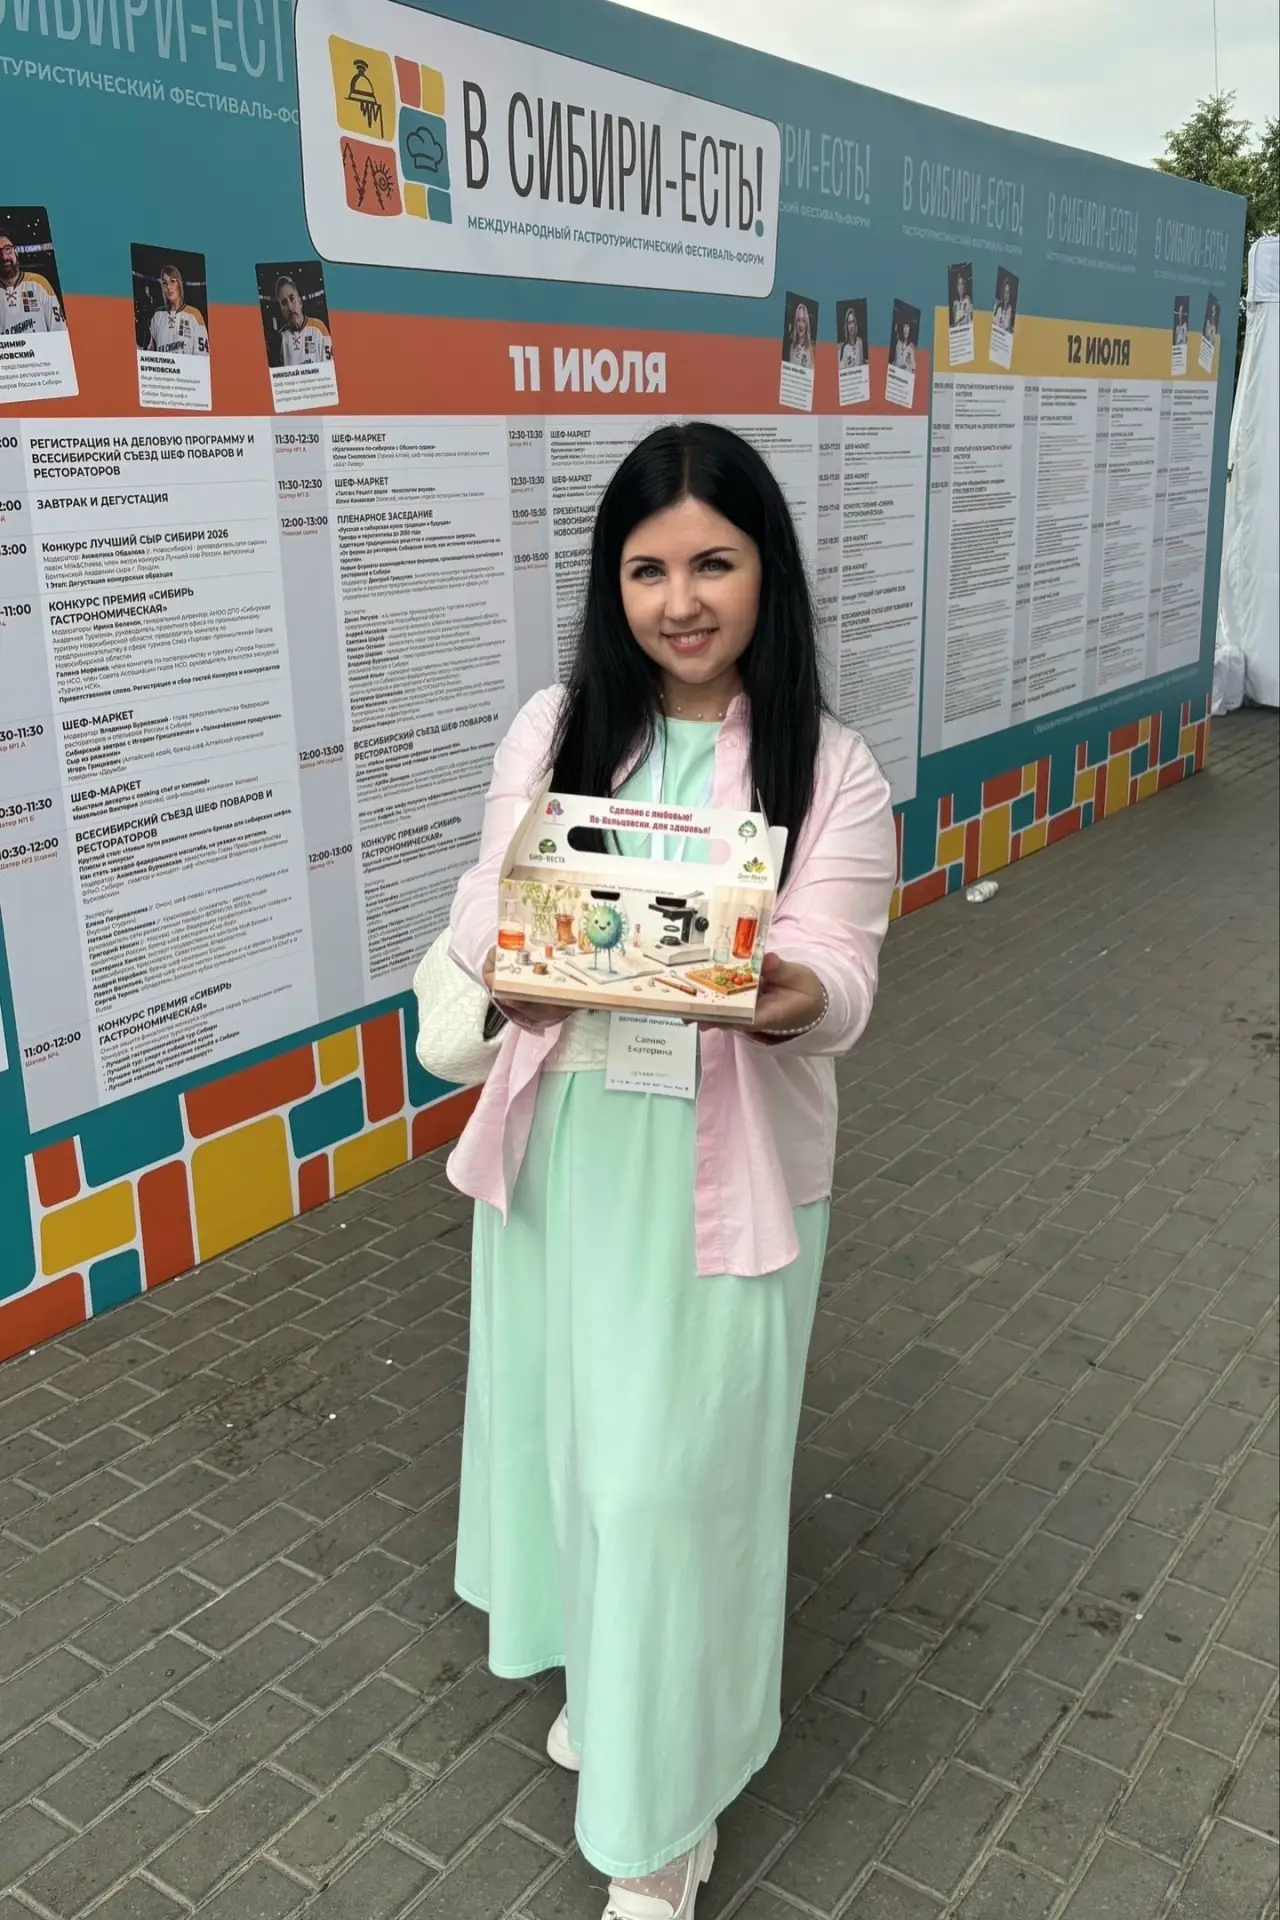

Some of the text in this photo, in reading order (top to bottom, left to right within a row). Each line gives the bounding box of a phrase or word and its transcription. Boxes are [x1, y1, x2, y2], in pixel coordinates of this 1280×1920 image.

[463, 80, 765, 238] В СИБИРИ-ЕСТЬ!
[780, 122, 871, 206] РИ-ЕСТЬ!
[902, 155, 1025, 236] В СИБИРИ-ЕСТЬ!
[1047, 191, 1056, 239] В
[467, 215, 764, 266] МЕЖДУНАРОДНЫЙ ГАСТРОТУРИСТИЧЕСКИЙ ФЕСТИВАЛЬ-ФОРУМ
[1068, 335, 1131, 366] 12 ИЮЛЯ
[140, 356, 175, 364] АНЖЕЛИКА
[140, 365, 181, 374] БУРКОВСКАЯ
[272, 369, 300, 379] НИКОЛАЙ
[509, 345, 666, 394] 11 ИЮЛЯ
[30, 434, 254, 449] РЕГИСТРАЦИЯ НА ДЕЛОВУЮ ПРОГРАММУ И
[275, 434, 320, 444] 11:30-12:30
[332, 433, 386, 443] ШЕФ-МАРКЕТ
[508, 430, 543, 440] 12:30-13:30
[550, 430, 591, 439] ШЕФ-МАРКЕТ
[32, 448, 244, 464] ВСЕСИБИРСКИЙ СЪЕЗД ШЕФ ПОВАРОВ И
[33, 466, 120, 478] РЕСТОРАТОРОВ
[552, 475, 592, 484] ШЕФ-МАРКЕТ
[278, 479, 322, 490] 11:30-12:30
[335, 477, 388, 487] ШЕФ-МАРКЕТ
[510, 476, 545, 486] 12:30-13:30
[37, 493, 168, 510] ЗАВТРАК И ДЕГУСТАЦИЯ
[553, 505, 595, 515] ПРЕЗЕНТАЦИЯ
[281, 516, 328, 527] 12:00-13:00
[337, 510, 433, 524] ПЛЕНАРНОЕ ЗАСЕДАНИЕ
[512, 508, 546, 518] 13:00-15:30
[42, 529, 229, 553] Конкурс ЛУЧШИЙ СЫР СИБИРИ 2026
[81, 551, 114, 559] Анжелика
[514, 552, 549, 563] 13:00-15:00
[50, 581, 67, 589] Этап:
[68, 578, 105, 588] Дегустация
[107, 575, 144, 584] конкурсных
[145, 571, 173, 580] образцов
[49, 588, 194, 612] КОНКУРС ПРЕМИЯ «СИБИРЬ
[50, 604, 168, 626] ГАСТРОНОМИЧЕСКАЯ»
[56, 670, 80, 678] Галина
[59, 689, 111, 703] Приветственное
[113, 687, 132, 695] слово.
[133, 679, 172, 692] Регистрация
[177, 677, 191, 685] сбор
[62, 710, 134, 731] ШЕФ-МАРКЕТ
[100, 724, 132, 734] Владимир
[133, 717, 168, 729] Бурковский
[353, 713, 499, 750] ВСЕСИБИРСКИЙ СЪЕЗД ШЕФ ПОВАРОВ И
[299, 743, 344, 762] 12:00-13:00
[354, 741, 414, 762] РЕСТОРАТОРОВ
[71, 780, 141, 803] ШЕФ-МАРКЕТ
[104, 796, 130, 806] десерты
[136, 788, 160, 798] cooking
[160, 785, 173, 793] chef
[75, 789, 273, 842] ВСЕСИБИРСКИЙ СЪЕЗД ШЕФ ПОВАРОВ И
[609, 806, 643, 816] Сделано
[652, 811, 693, 821] любовью!
[361, 815, 462, 850] КОНКУРС ПРЕМИЯ «СИБИРЬ
[652, 822, 668, 830] для
[76, 829, 158, 855] РЕСТОРАТОРОВ
[361, 832, 443, 860] ГАСТРОНОМИЧЕСКАЯ»
[308, 843, 353, 864] 12:00-13:00
[98, 982, 232, 1033] КОНКУРС ПРЕМИЯ «СИБИРЬ
[100, 1002, 208, 1046] ГАСТРОНОМИЧЕСКАЯ»
[24, 1031, 82, 1058] 11:00-12:00
[628, 1045, 672, 1056] Екатерина
